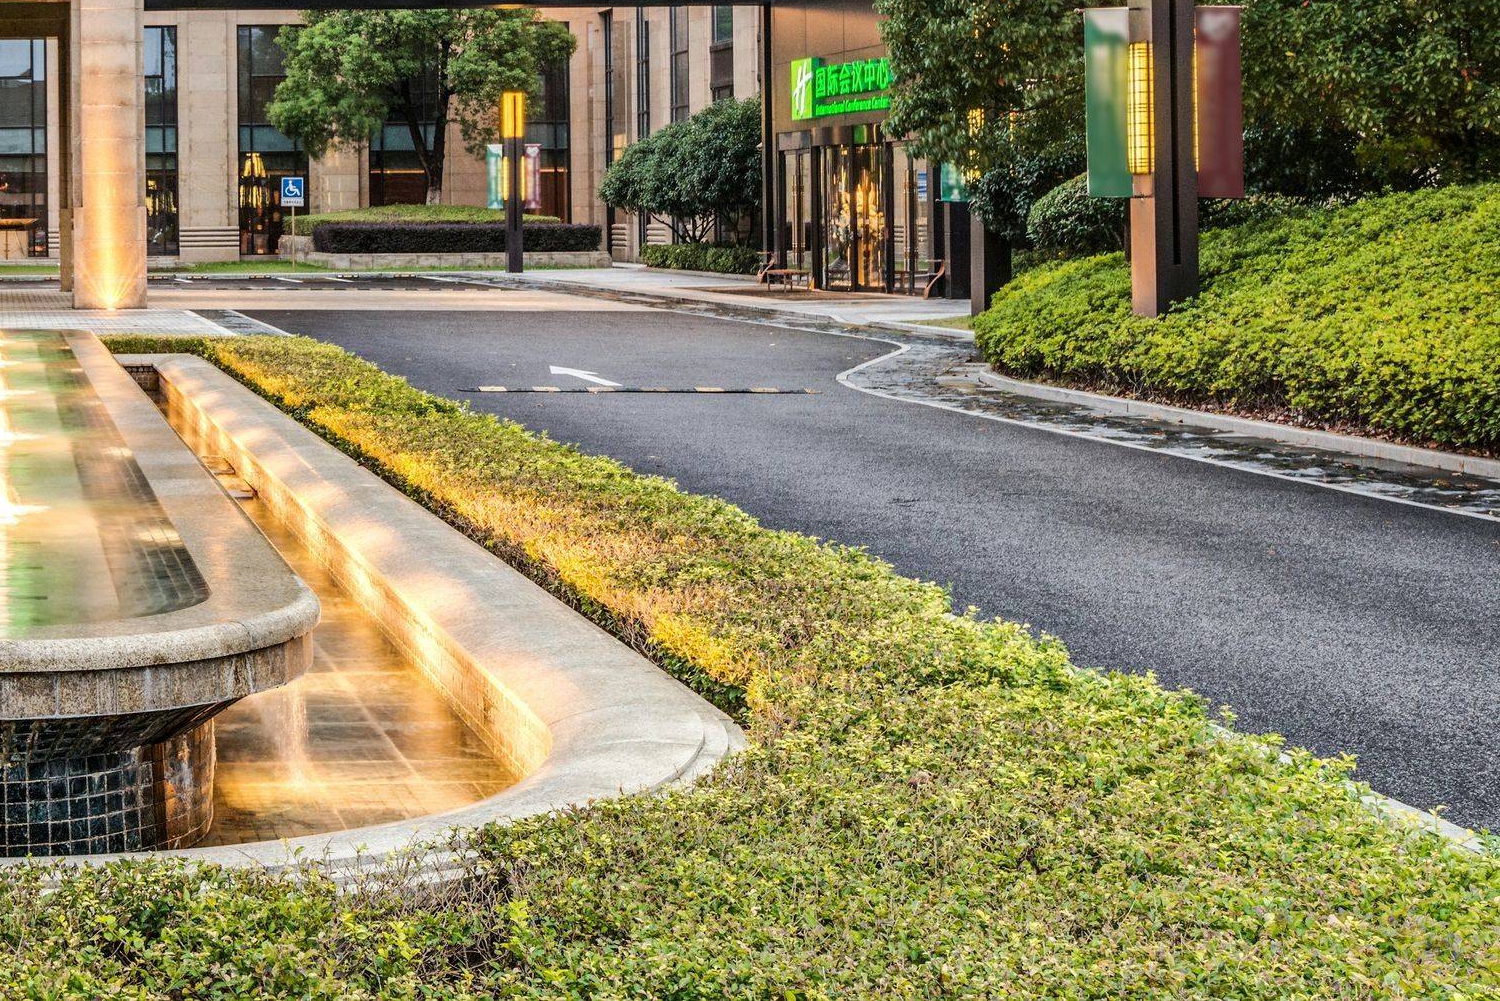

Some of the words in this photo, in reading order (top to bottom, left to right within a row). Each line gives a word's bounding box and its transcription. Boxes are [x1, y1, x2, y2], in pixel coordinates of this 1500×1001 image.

[815, 57, 889, 98] 国际会议中心
